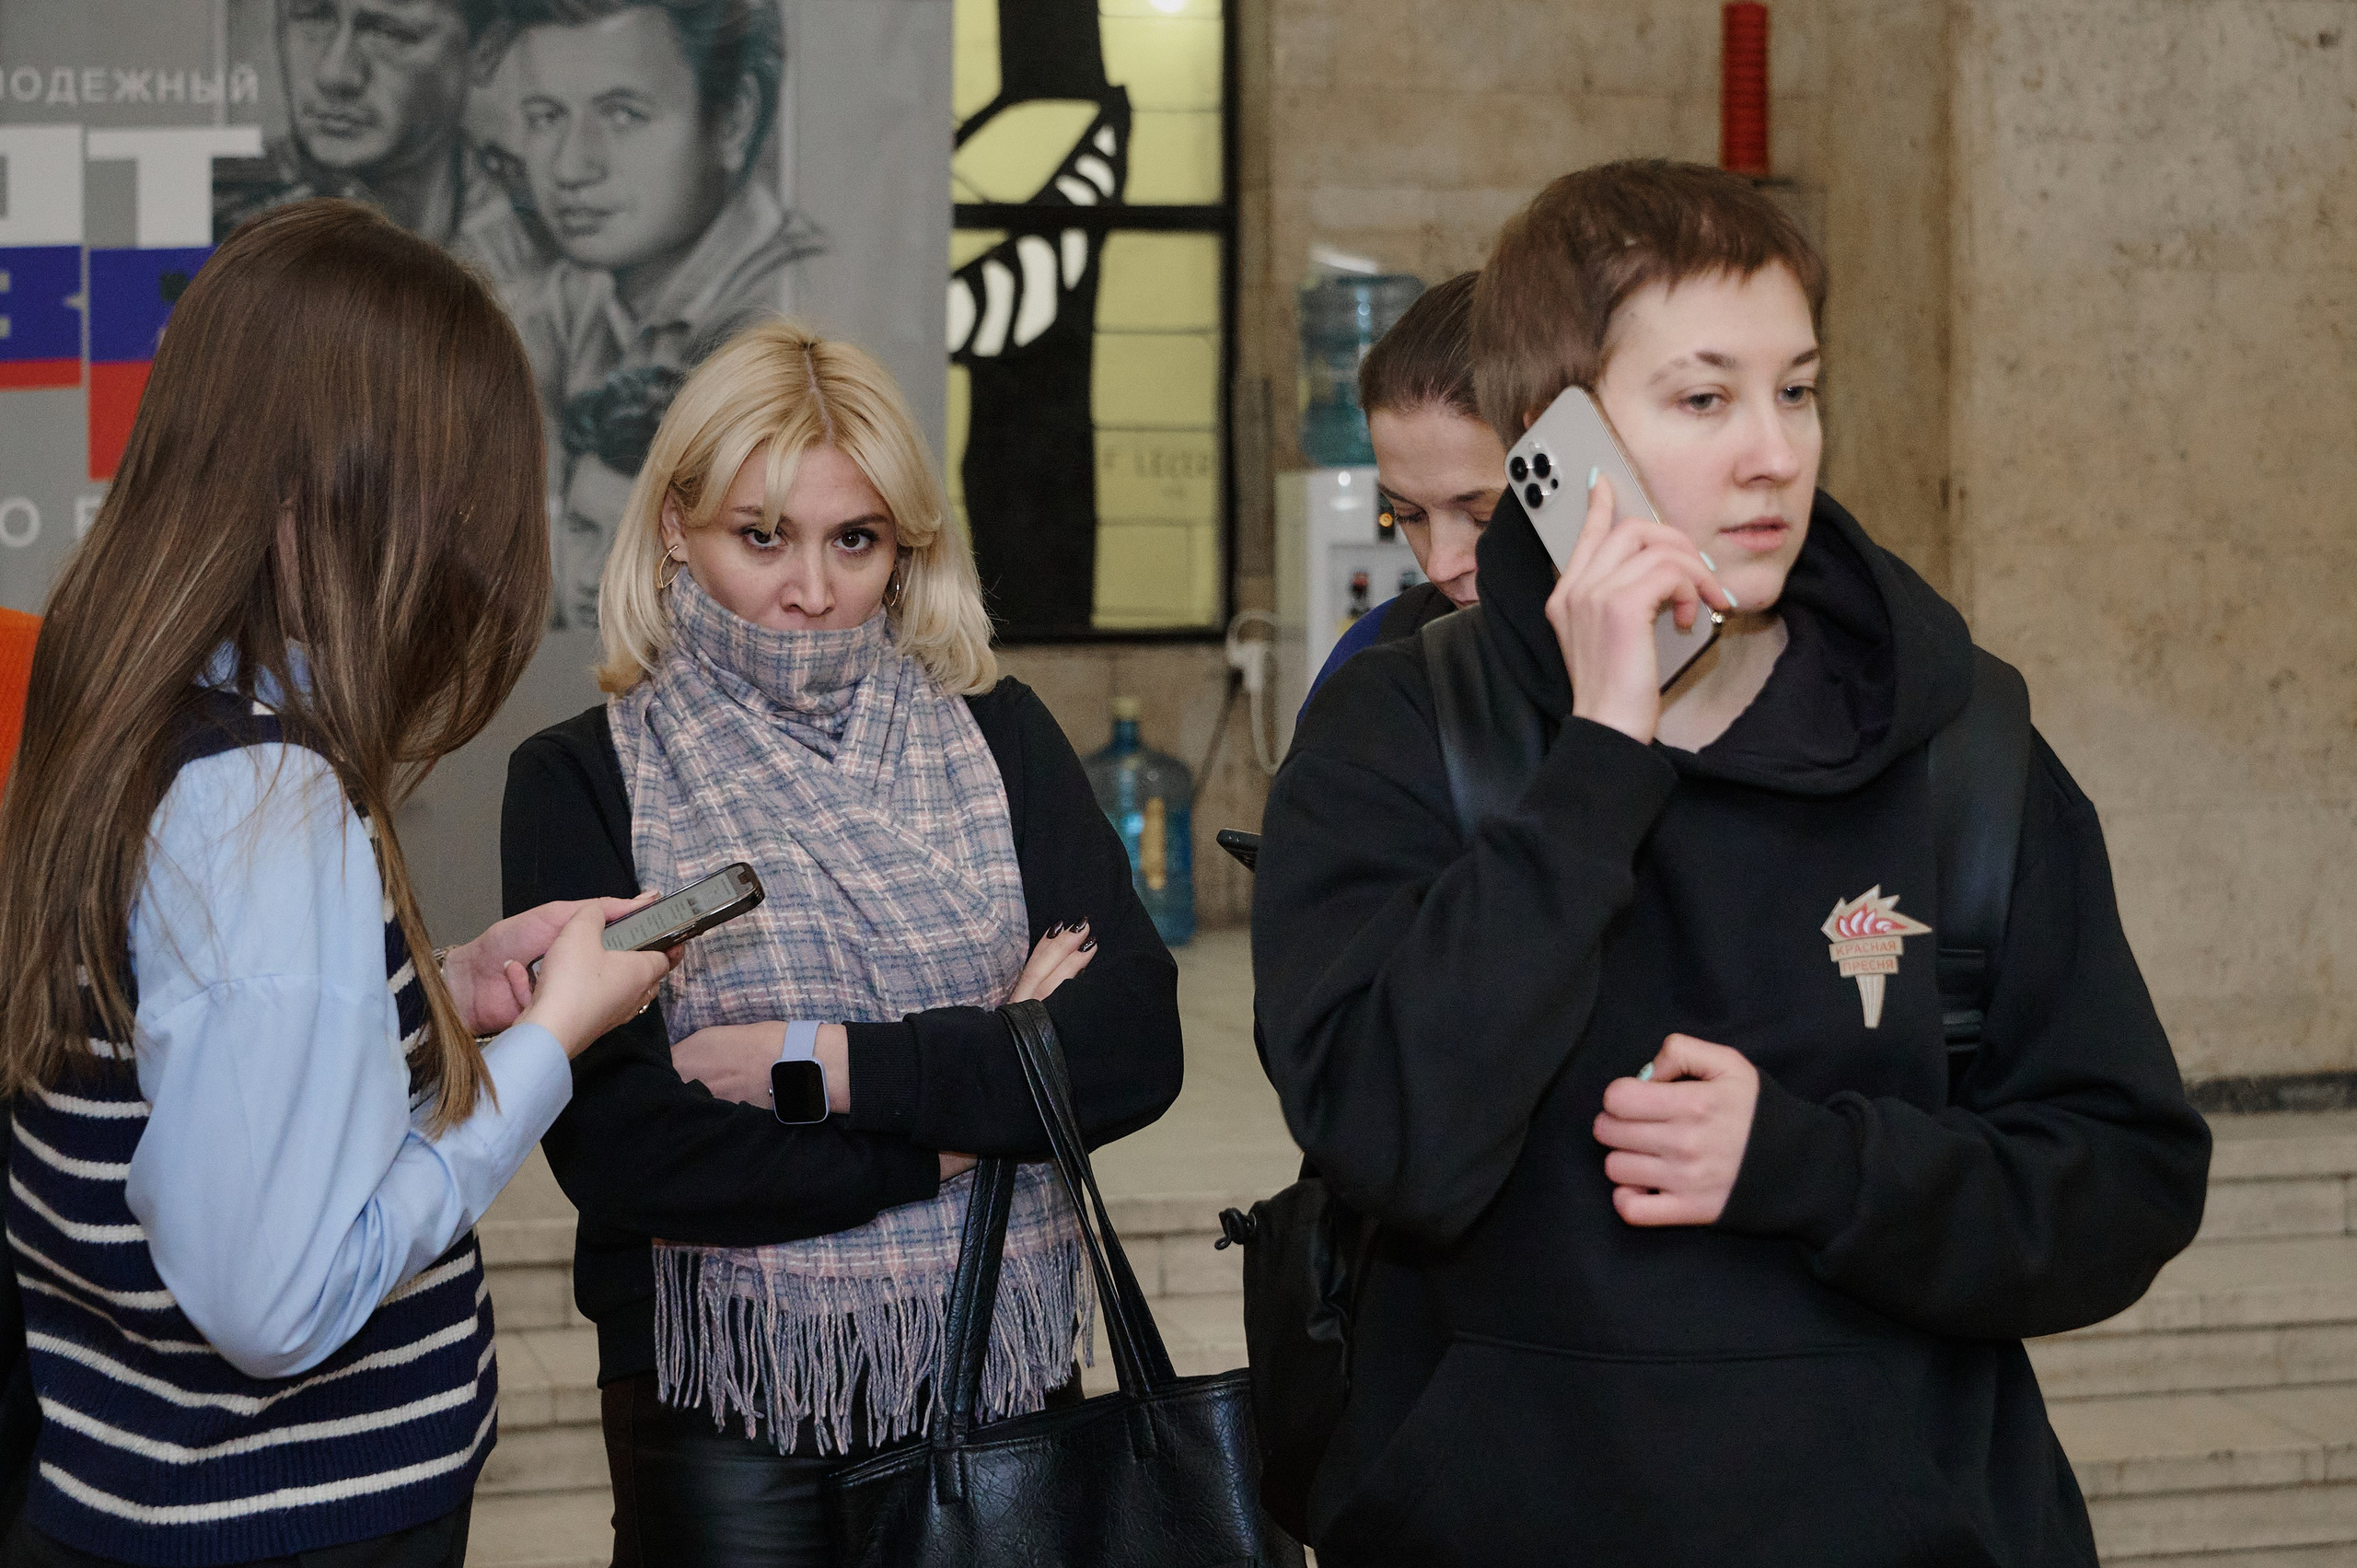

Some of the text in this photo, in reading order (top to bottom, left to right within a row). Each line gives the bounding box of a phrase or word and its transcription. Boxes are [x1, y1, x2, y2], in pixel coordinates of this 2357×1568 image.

[0, 64, 260, 106] ОДЕЖНЫЙ
[1836, 940, 1897, 957] КРАСНАЯ
[1842, 958, 1894, 972] ПРЕСНЯ
